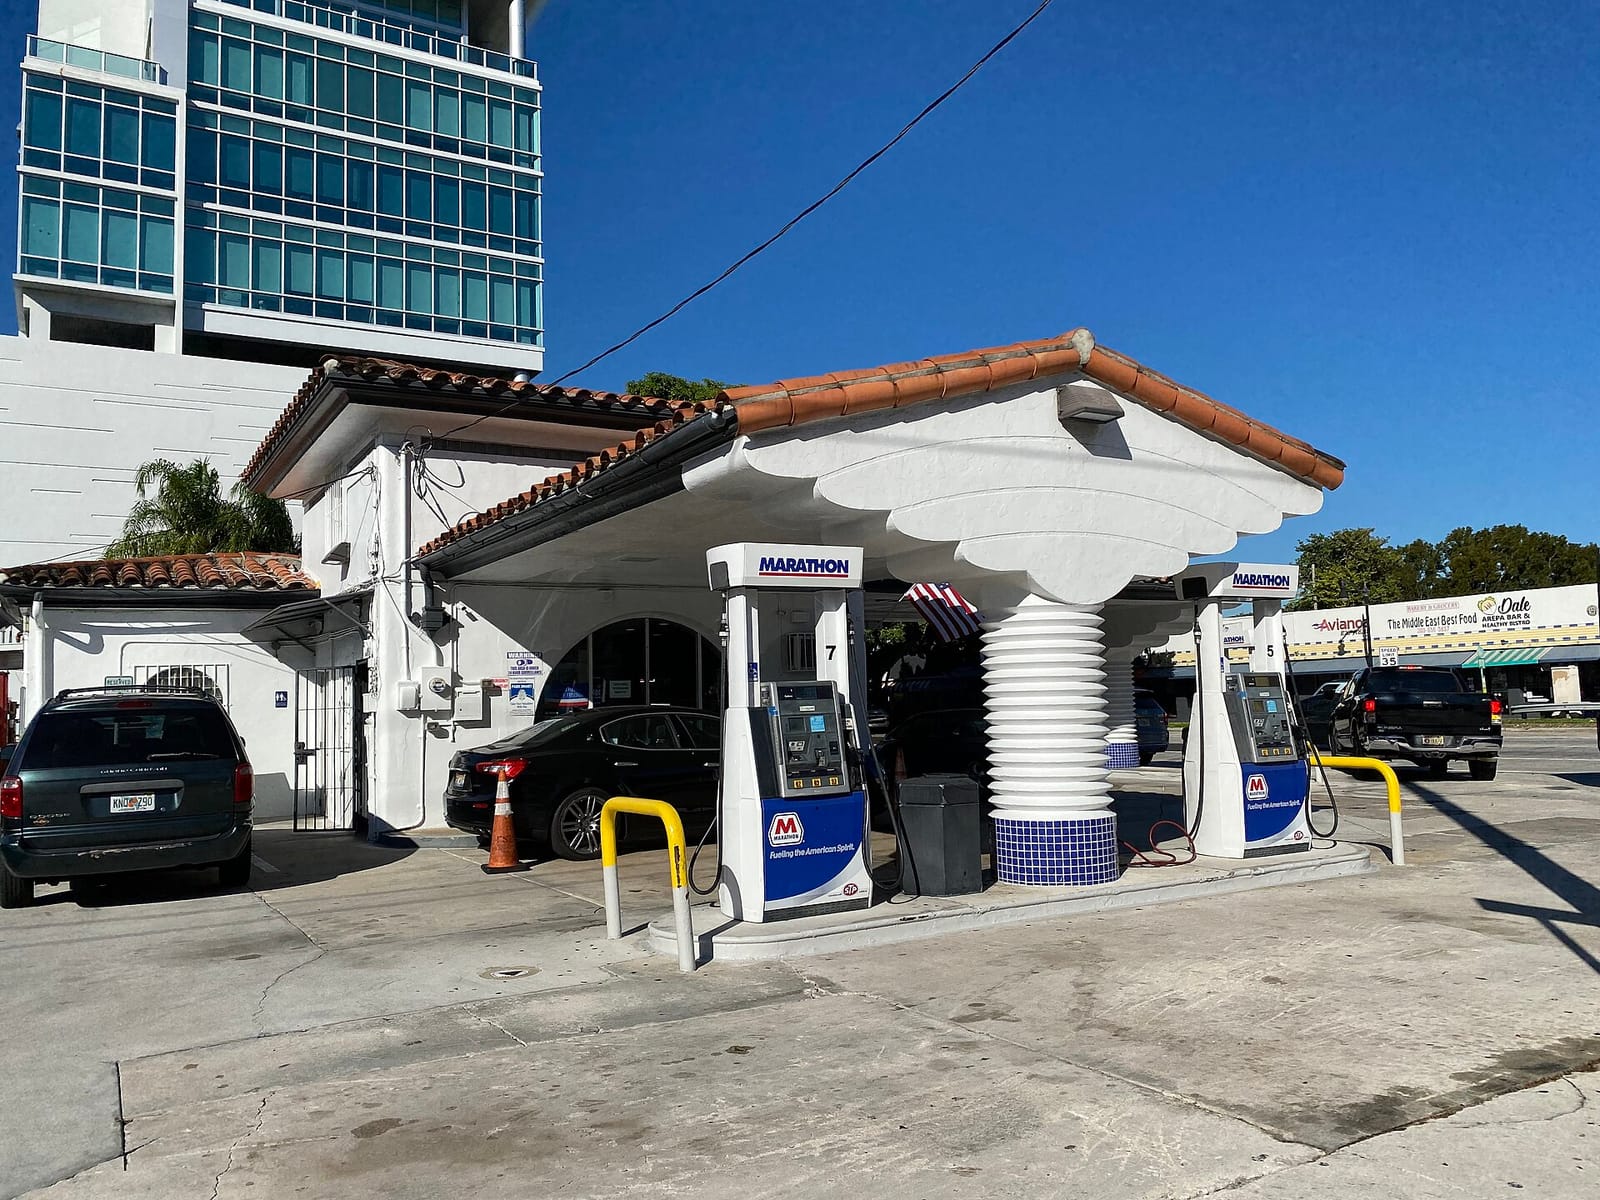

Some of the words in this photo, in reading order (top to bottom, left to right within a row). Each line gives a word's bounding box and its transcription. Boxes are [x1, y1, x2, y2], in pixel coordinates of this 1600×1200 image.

[759, 557, 848, 573] MARATHON
[1232, 573, 1290, 586] MARATHON
[1498, 596, 1531, 614] Dale
[1388, 619, 1401, 630] The
[1402, 616, 1424, 629] Middle
[1425, 615, 1440, 627] East
[1441, 614, 1458, 626] Best
[1459, 612, 1478, 625] Food
[1223, 635, 1245, 643] ATHON
[825, 645, 837, 660] 7
[1266, 645, 1274, 657] 5
[1382, 657, 1397, 665] 35
[1250, 778, 1265, 791] M
[1247, 803, 1262, 811] Fueling
[775, 818, 797, 835] M
[769, 850, 794, 860] Fueling
[795, 848, 804, 857] the
[805, 845, 836, 856] American
[837, 843, 855, 852] Spirit.
[844, 884, 858, 895] STP
